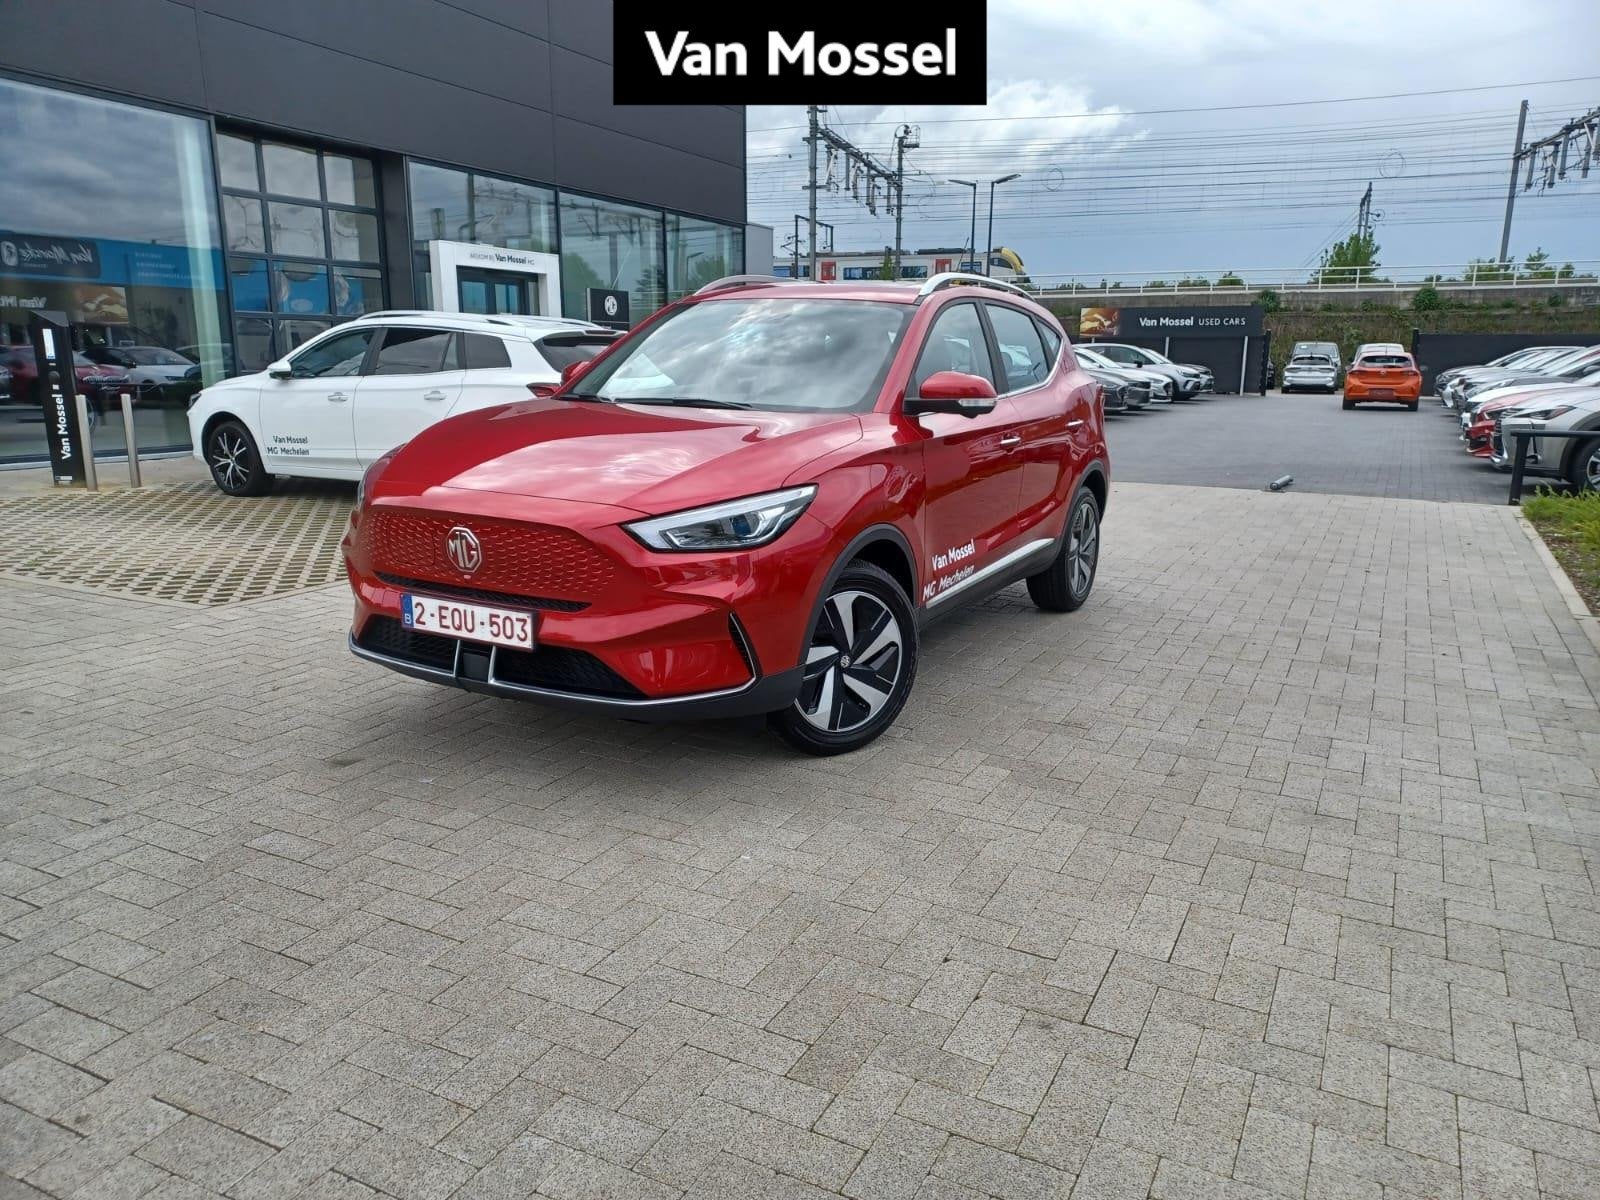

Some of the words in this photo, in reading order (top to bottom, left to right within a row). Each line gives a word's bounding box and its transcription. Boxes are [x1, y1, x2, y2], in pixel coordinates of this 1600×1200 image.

[495, 253, 507, 263] Van
[507, 254, 527, 265] Mossel
[1139, 316, 1158, 327] Van
[1159, 316, 1194, 327] Mossel
[1198, 317, 1221, 326] USED
[1223, 317, 1246, 326] CARS
[51, 393, 69, 435] Mossel
[273, 435, 287, 444] Van
[287, 435, 309, 444] Mossel
[60, 438, 72, 460] Van
[267, 447, 279, 455] MG
[281, 447, 310, 456] Mechelen
[448, 528, 481, 572] MG
[931, 554, 948, 571] Van
[948, 538, 976, 564] Mossel
[922, 580, 937, 602] MG
[938, 565, 975, 592] Mechelen
[404, 612, 412, 625] B
